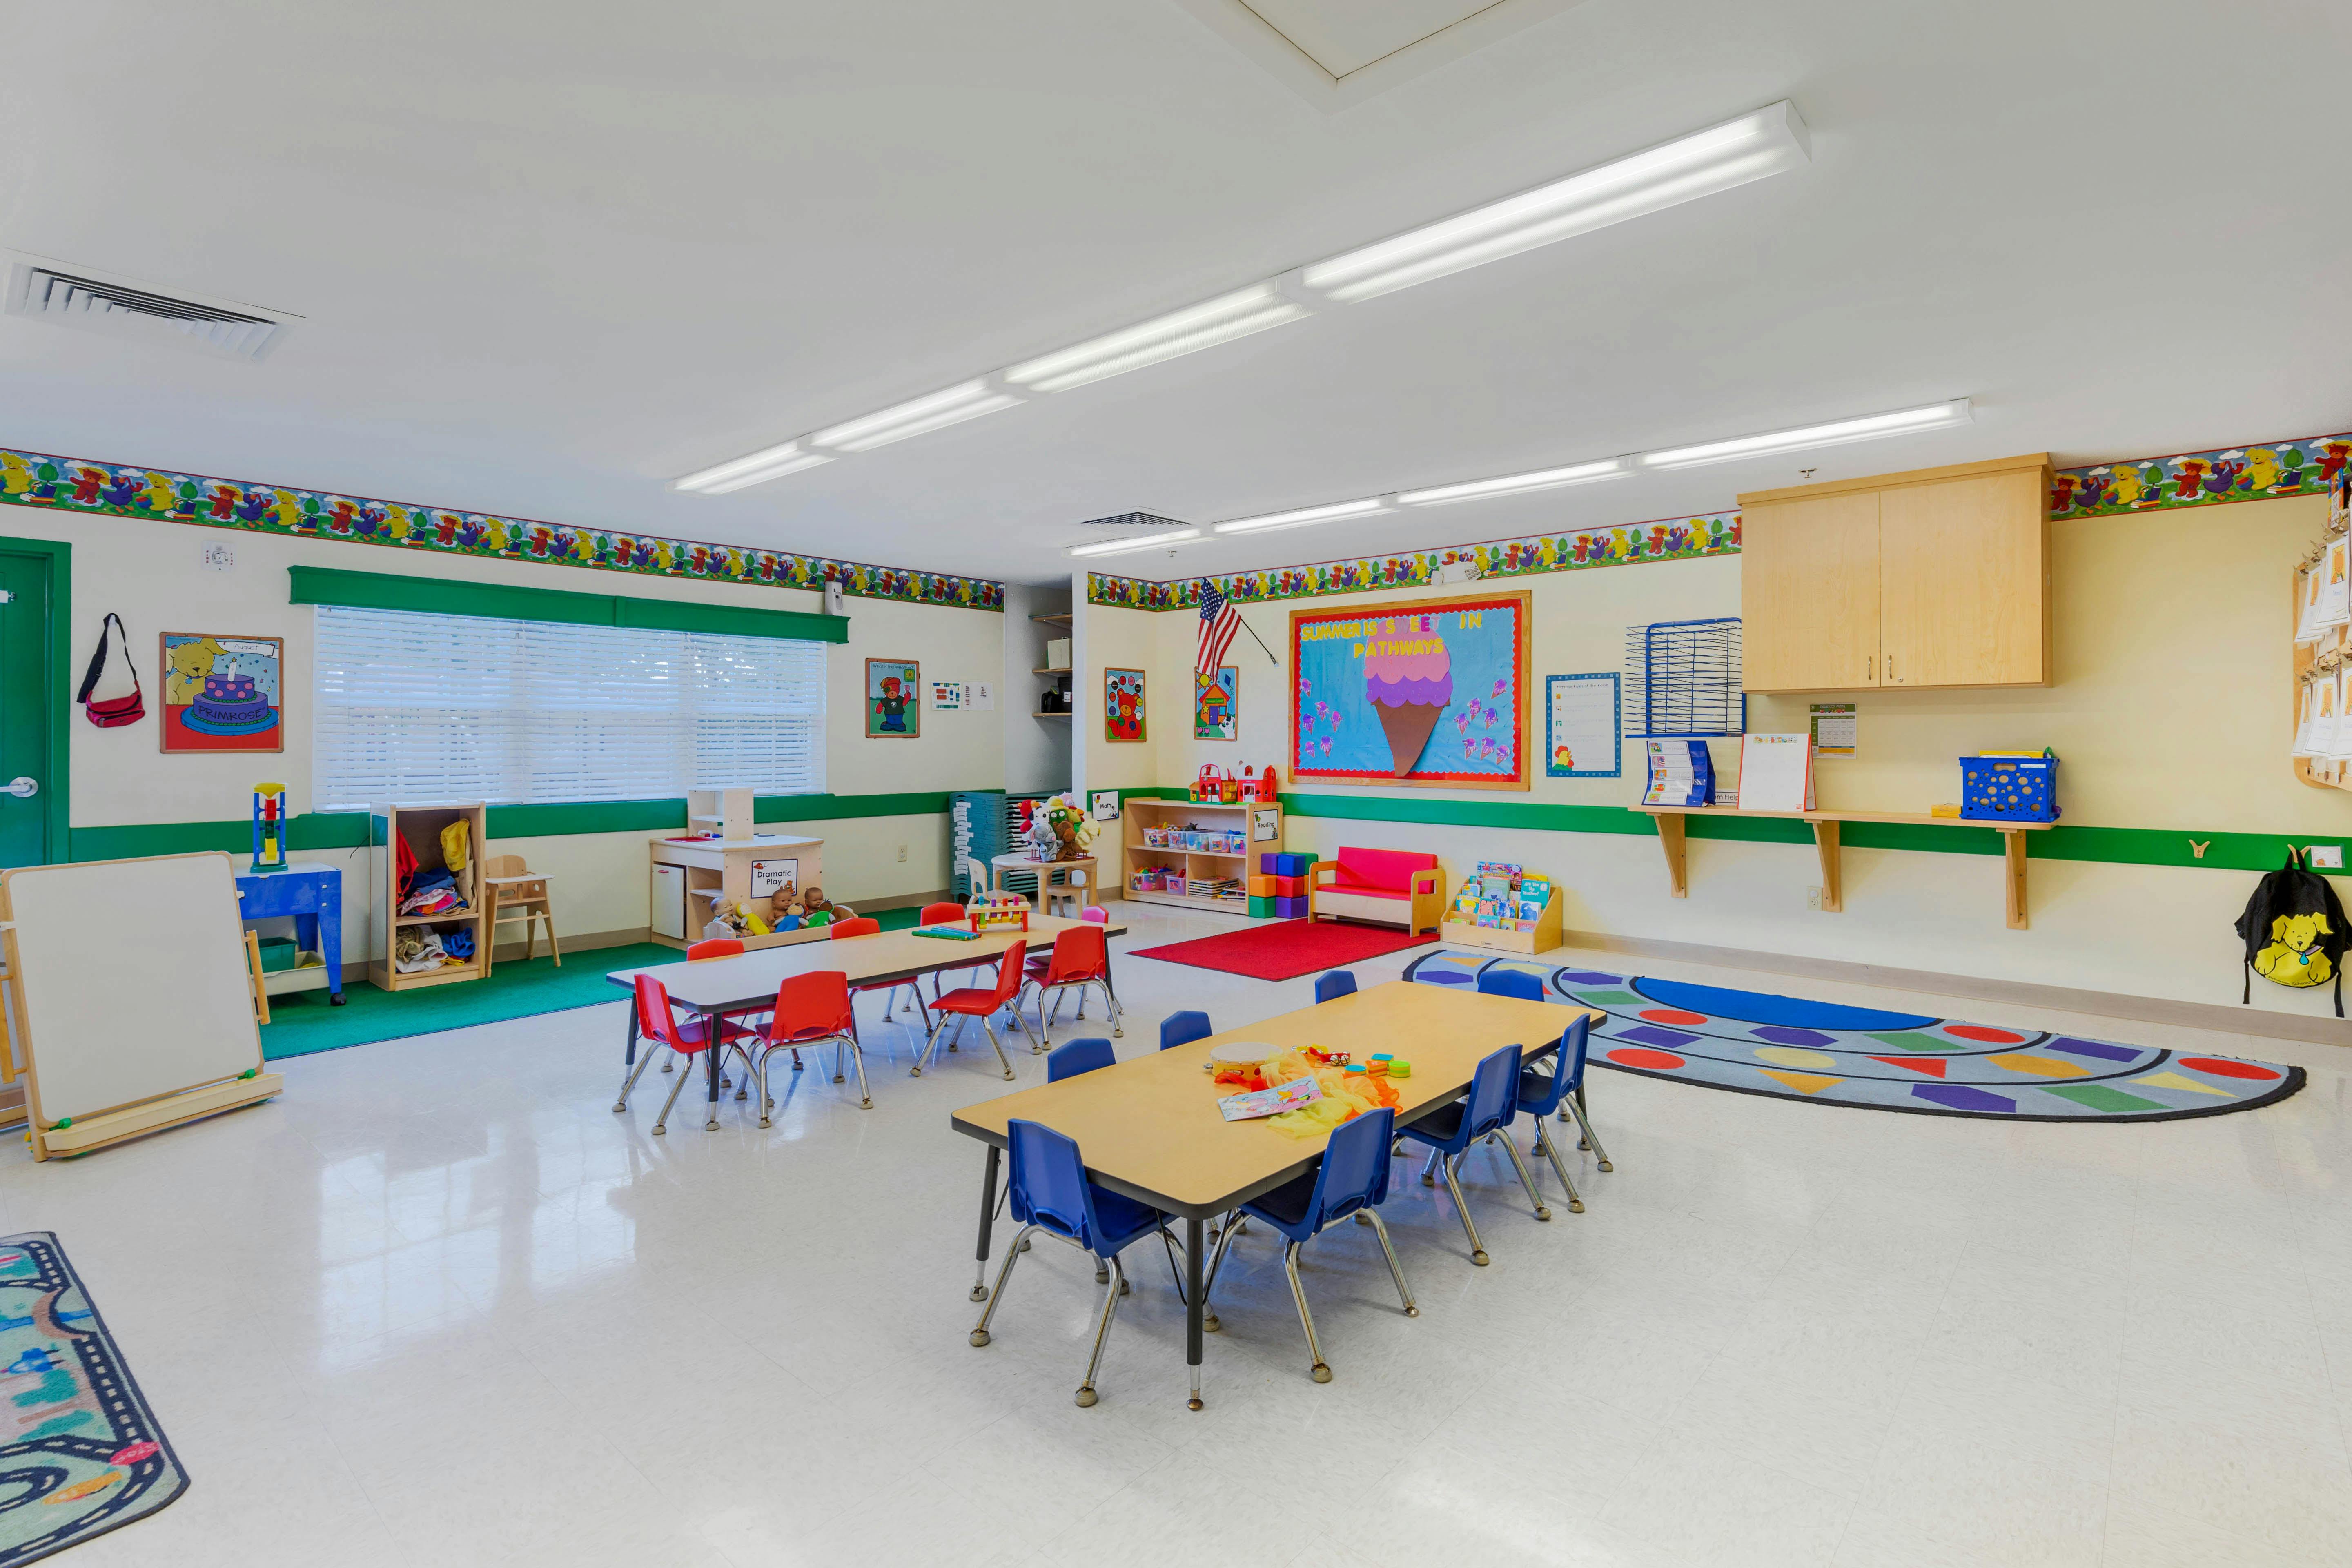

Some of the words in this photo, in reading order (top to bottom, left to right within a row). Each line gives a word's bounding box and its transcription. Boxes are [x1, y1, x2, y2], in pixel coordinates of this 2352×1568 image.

[1301, 622, 1361, 641] SUMMER
[1363, 621, 1378, 636] IS
[1385, 615, 1441, 635] SWEET
[1459, 612, 1482, 630] IN
[1354, 637, 1445, 659] PATHWAYS
[197, 705, 263, 721] PRIMROSE
